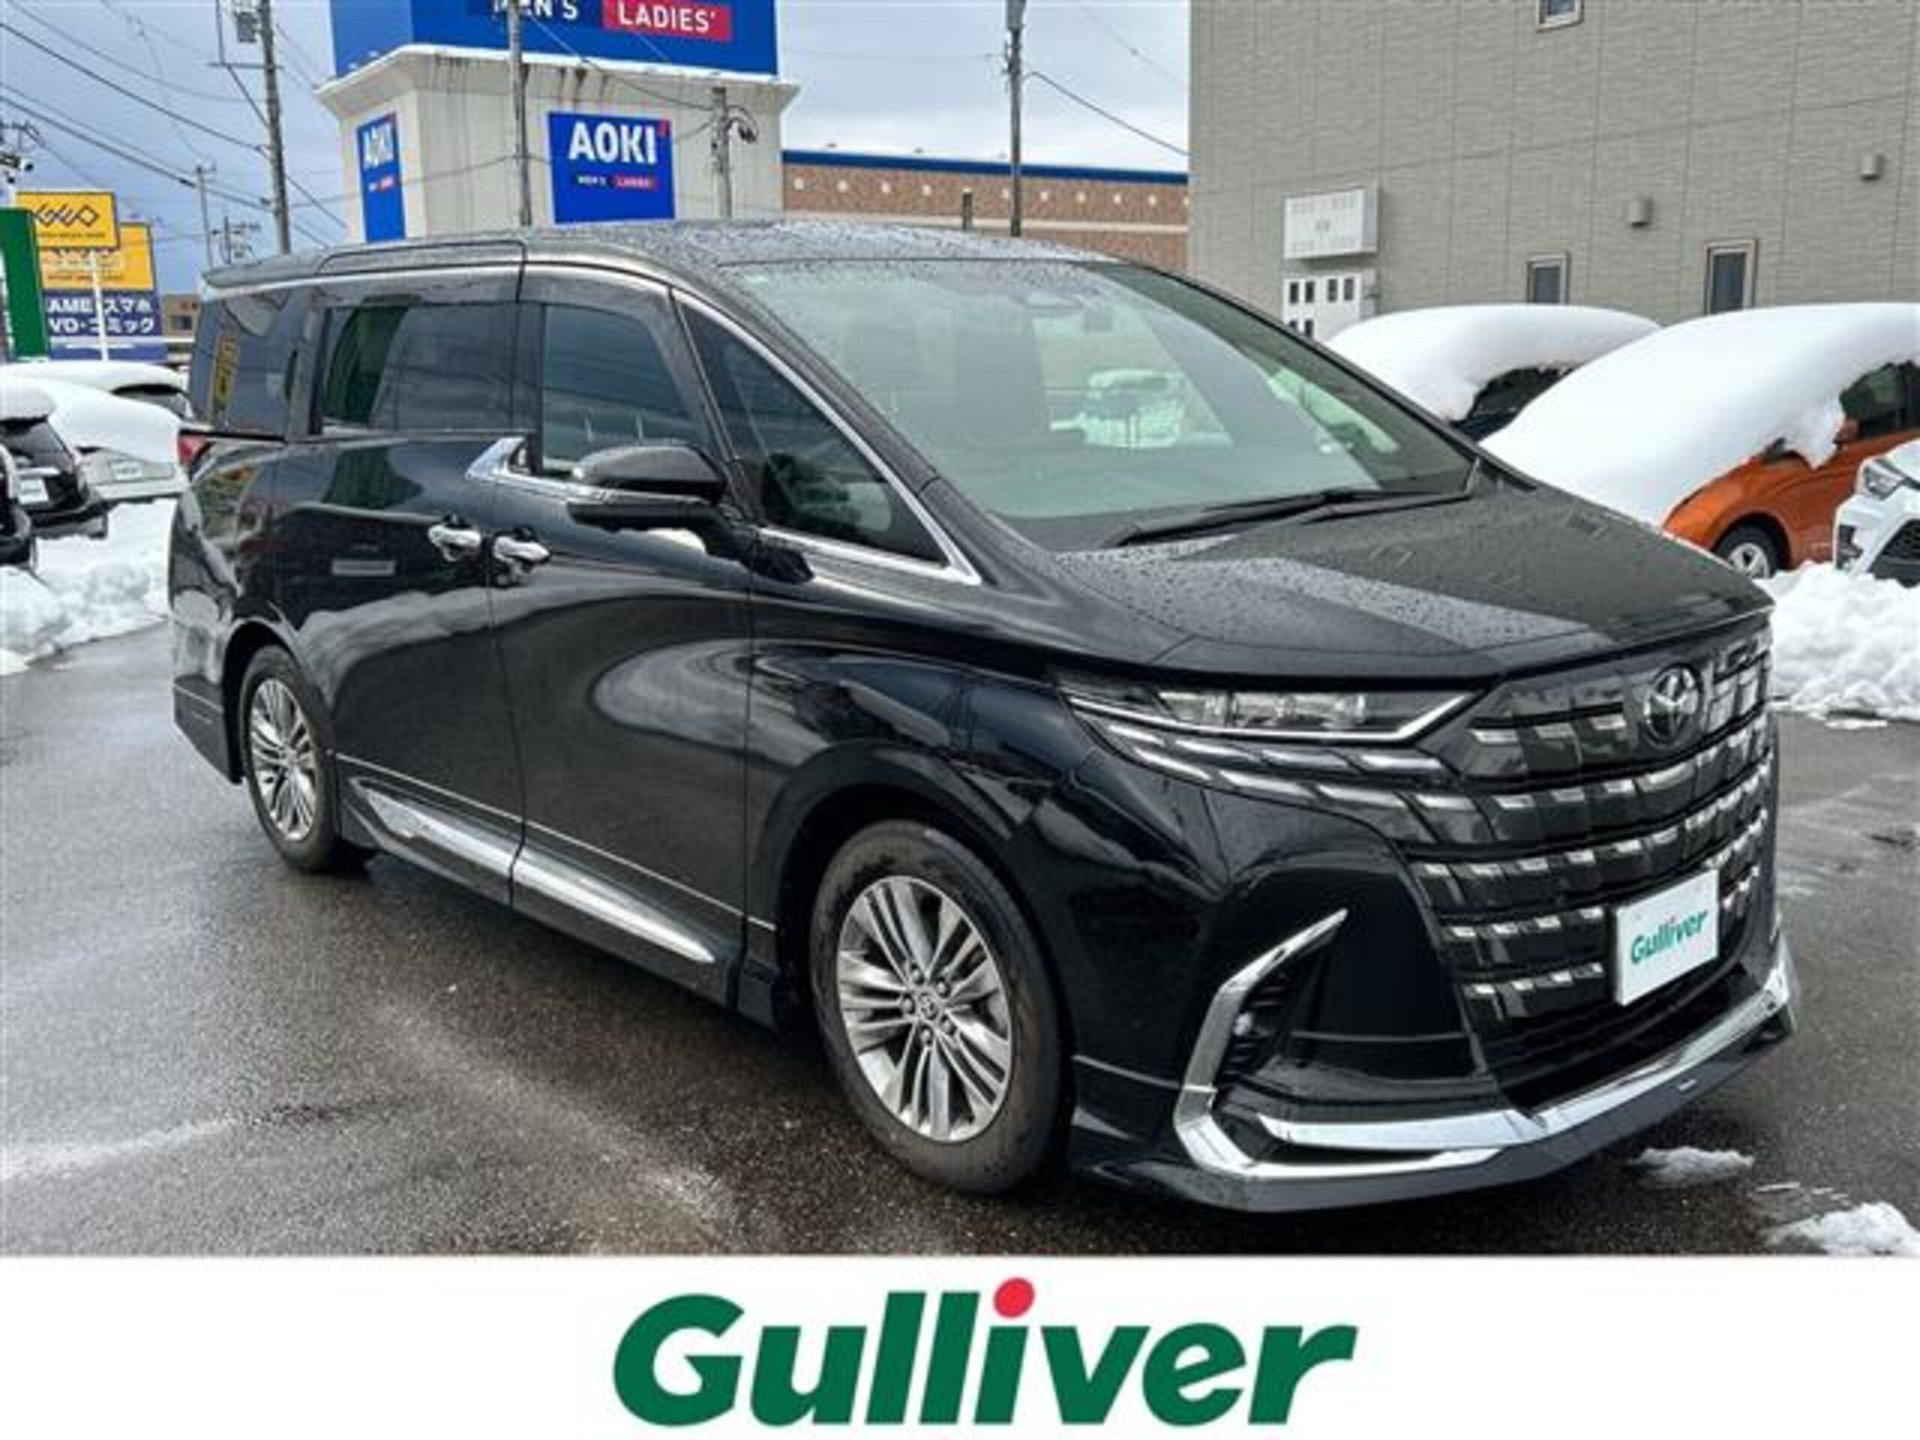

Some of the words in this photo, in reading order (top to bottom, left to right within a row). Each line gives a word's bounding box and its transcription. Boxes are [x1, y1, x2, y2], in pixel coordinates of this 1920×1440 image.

[617, 0, 716, 32] LADIES'
[568, 121, 657, 164] AOKI
[1631, 910, 1708, 965] Gulliver
